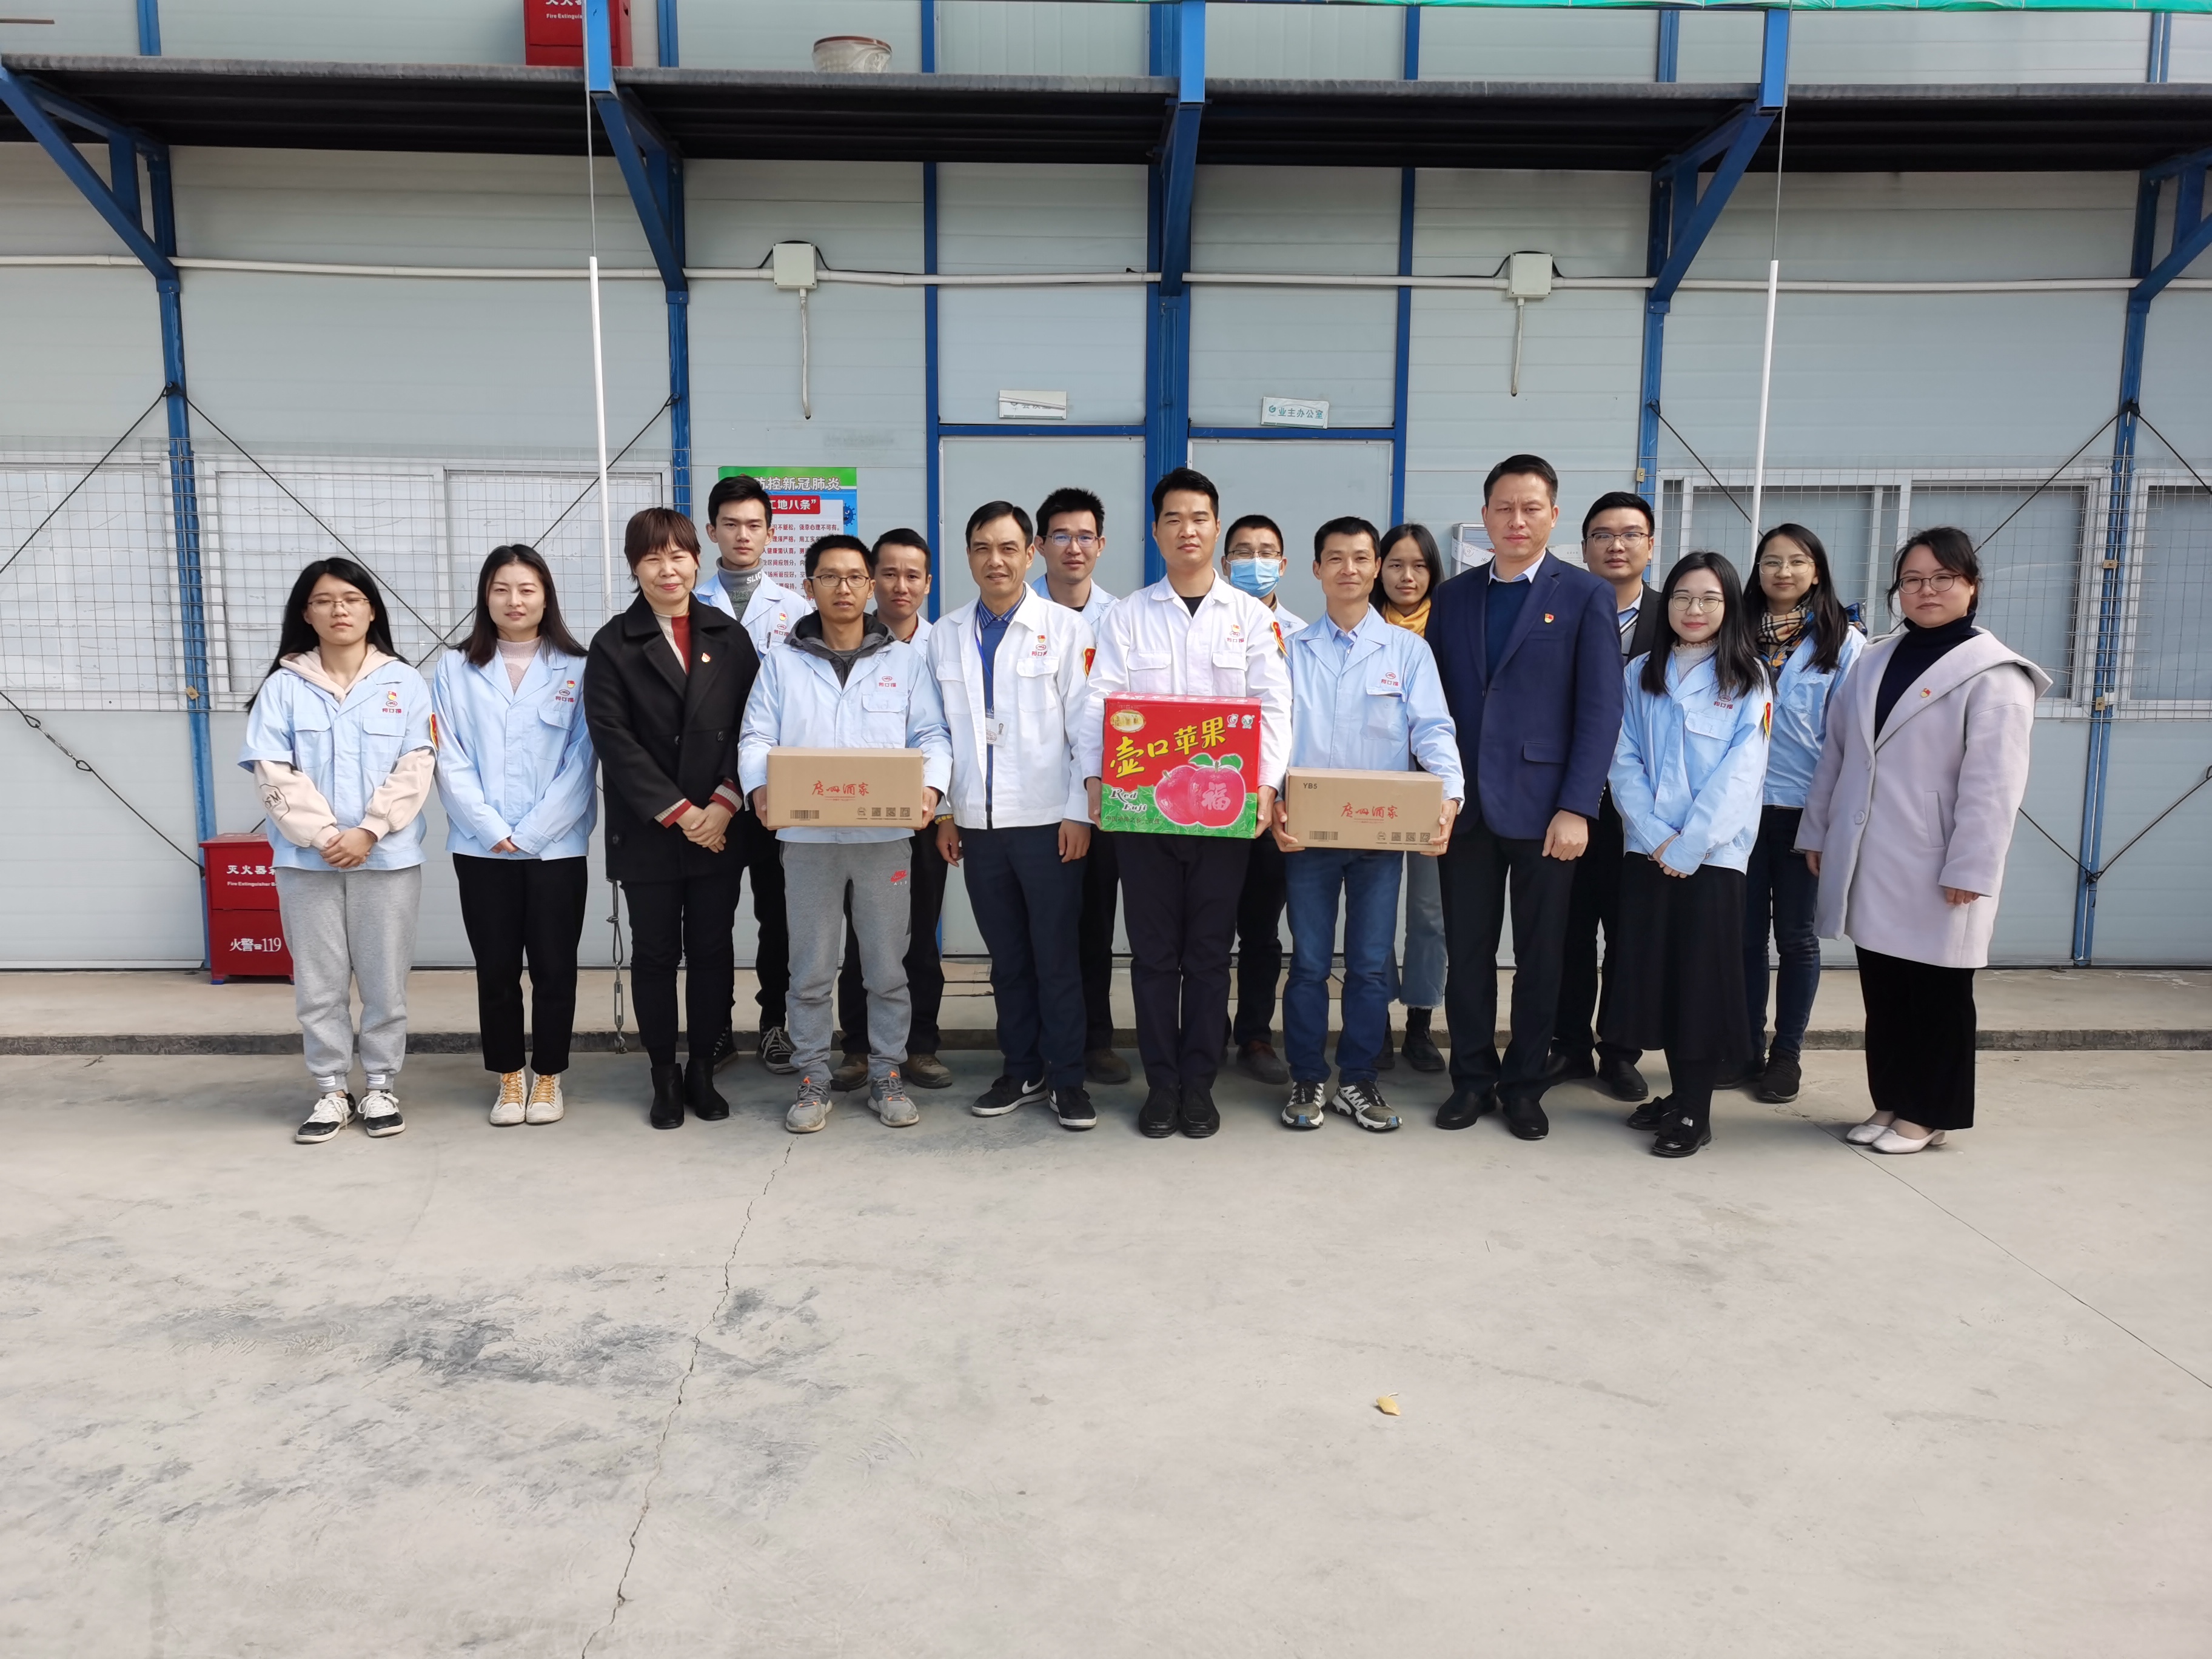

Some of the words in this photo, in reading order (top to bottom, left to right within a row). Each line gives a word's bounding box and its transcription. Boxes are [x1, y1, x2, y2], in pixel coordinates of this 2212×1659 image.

[1278, 407, 1323, 419] 业主办公室
[1110, 716, 1226, 778] 壶口苹果
[1109, 788, 1138, 803] Red
[1201, 782, 1231, 811] 福
[1122, 803, 1148, 813] Fuji
[229, 938, 254, 951] 火警
[261, 937, 281, 952] 119
